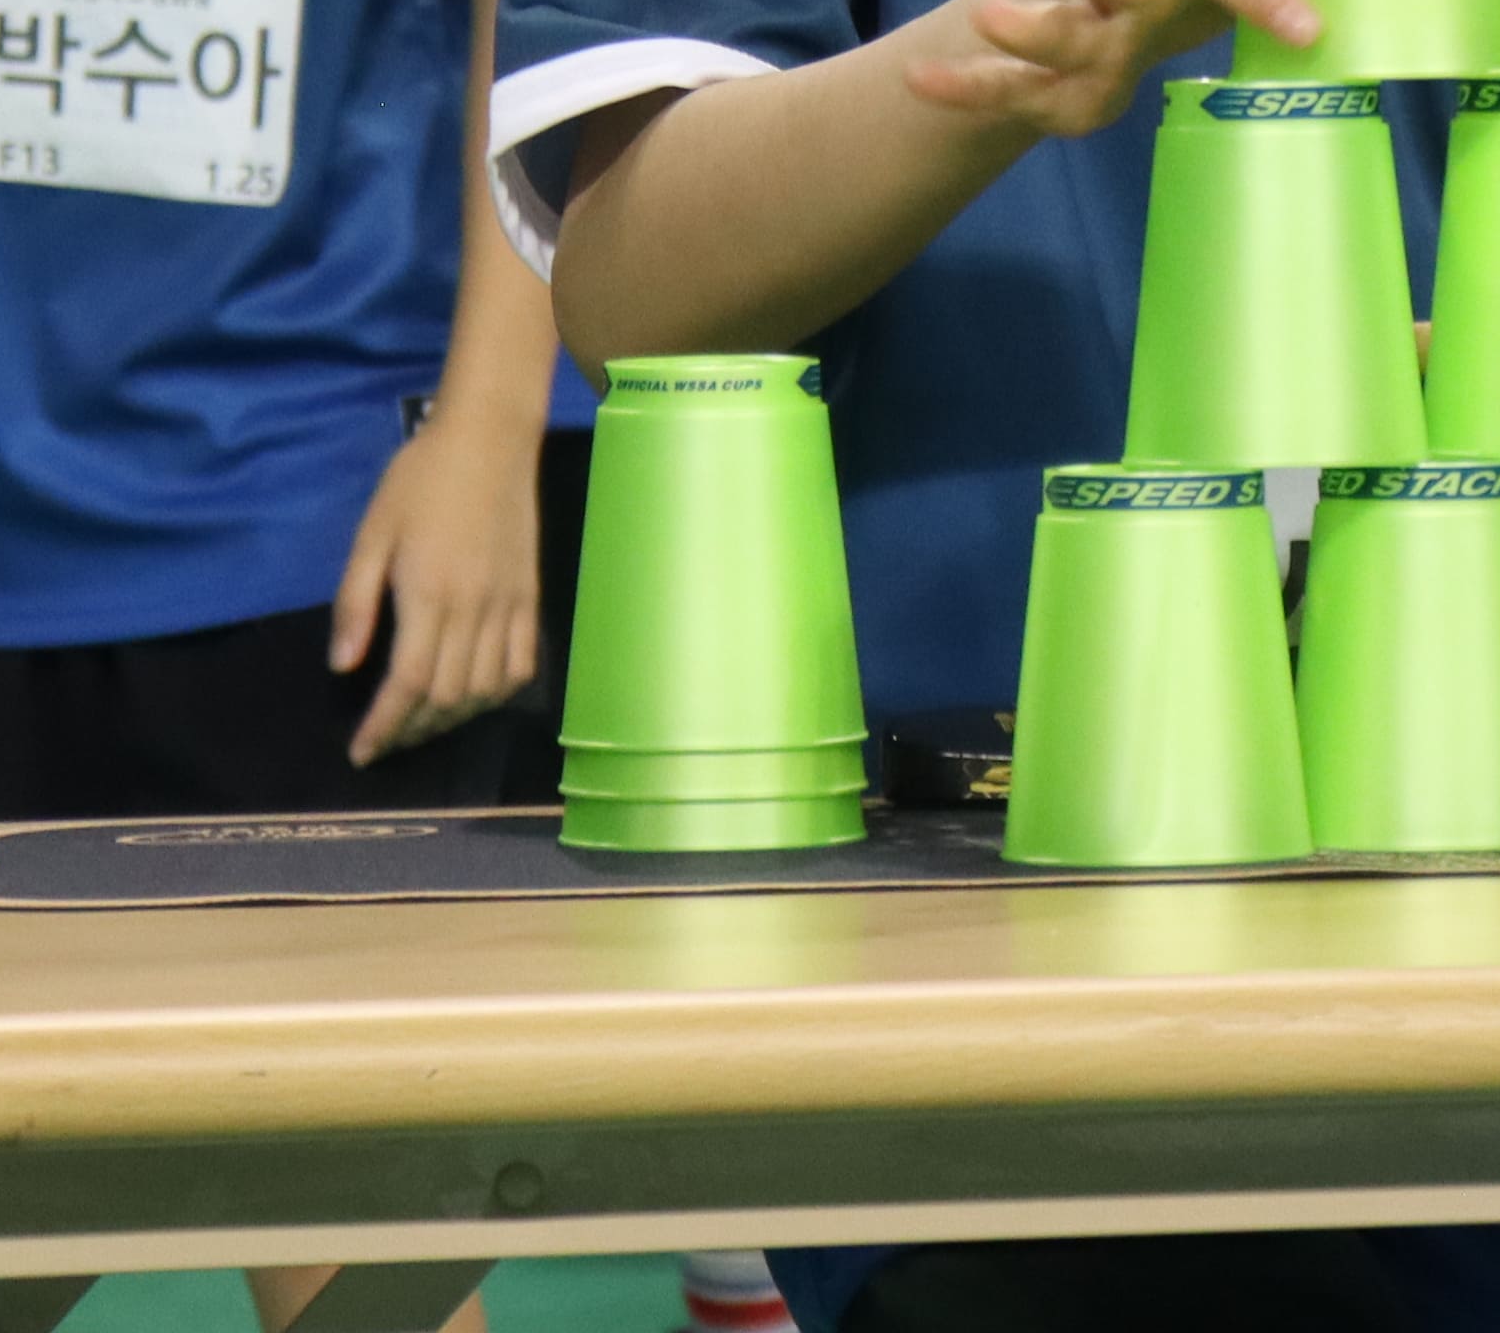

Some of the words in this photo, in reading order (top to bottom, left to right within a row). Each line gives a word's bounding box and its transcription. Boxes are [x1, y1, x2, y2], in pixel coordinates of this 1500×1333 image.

[1247, 90, 1378, 117] SPEED
[673, 380, 718, 393] WSSA
[721, 379, 764, 392] CUPS
[1070, 481, 1232, 507] SPEED
